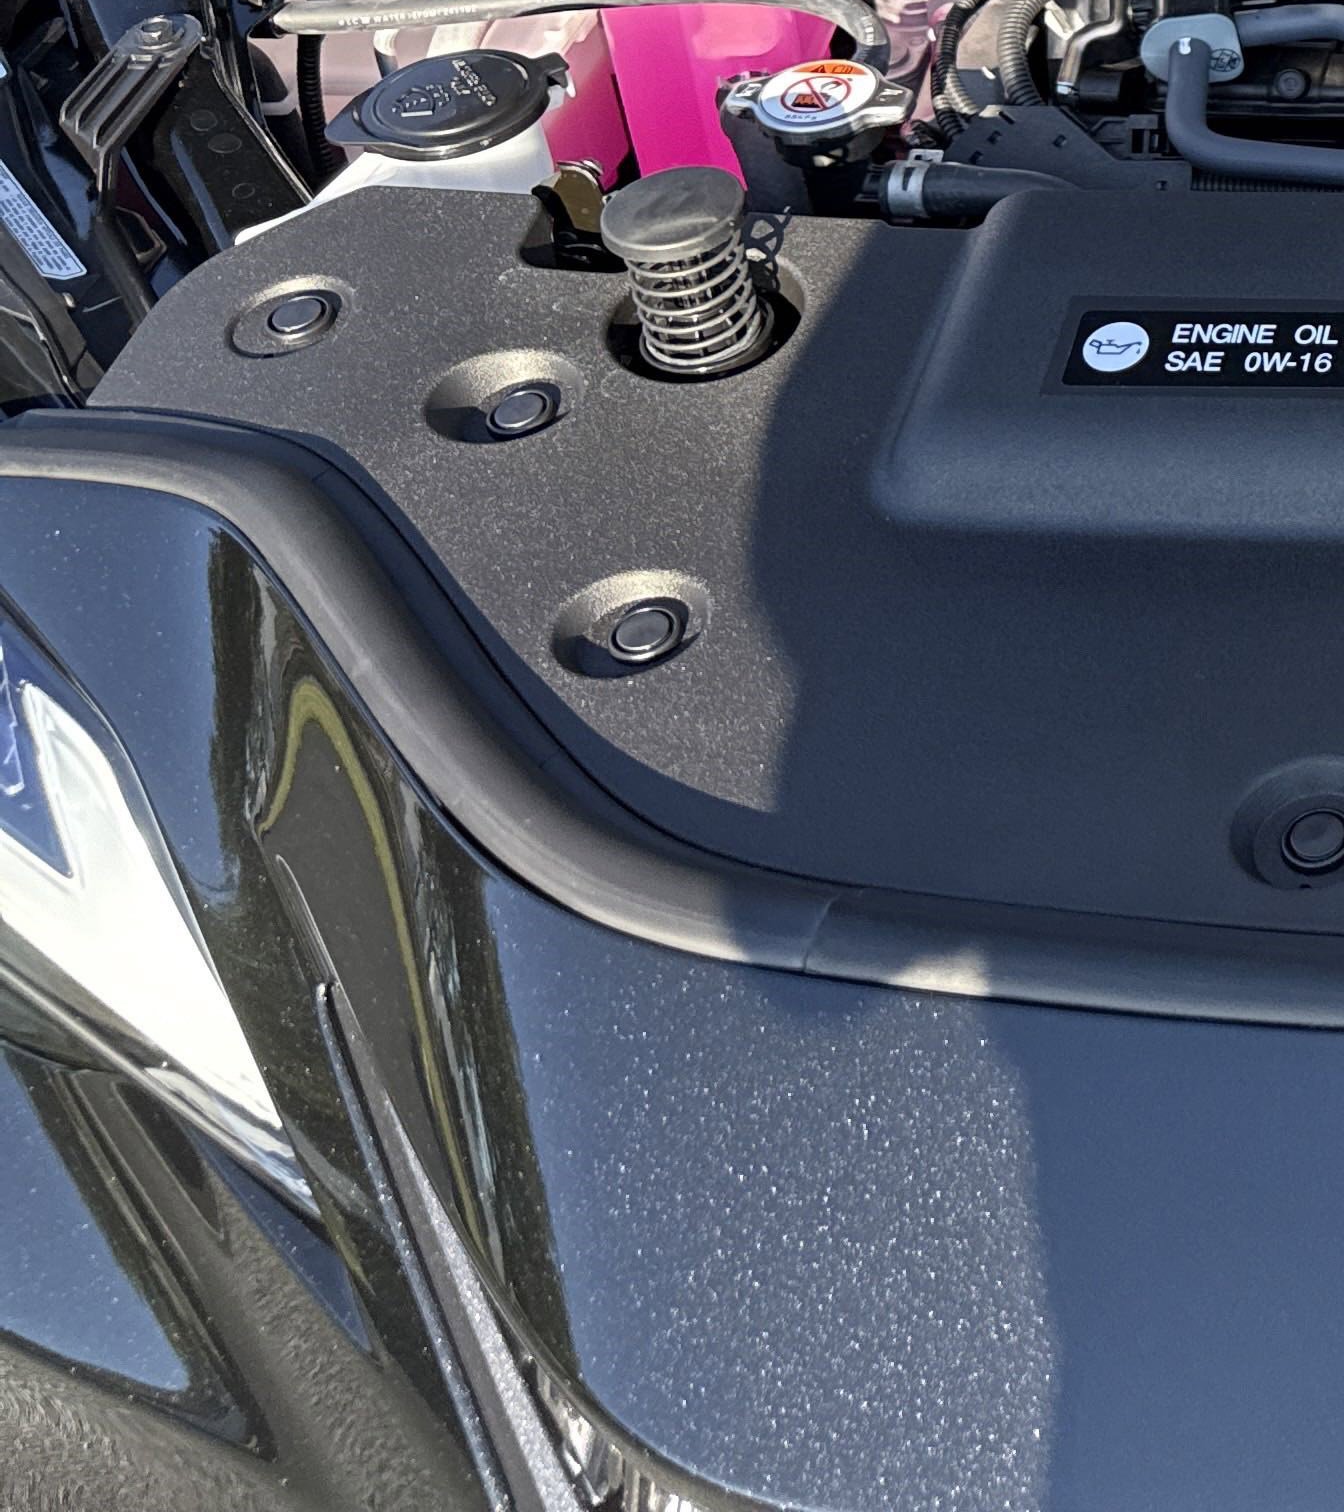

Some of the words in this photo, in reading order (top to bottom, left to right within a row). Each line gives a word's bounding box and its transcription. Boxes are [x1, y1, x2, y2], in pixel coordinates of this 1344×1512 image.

[1171, 323, 1277, 344] ENGINE
[1294, 324, 1339, 345] OIL
[1164, 350, 1225, 372] SAE
[1244, 352, 1333, 373] 0W-16
